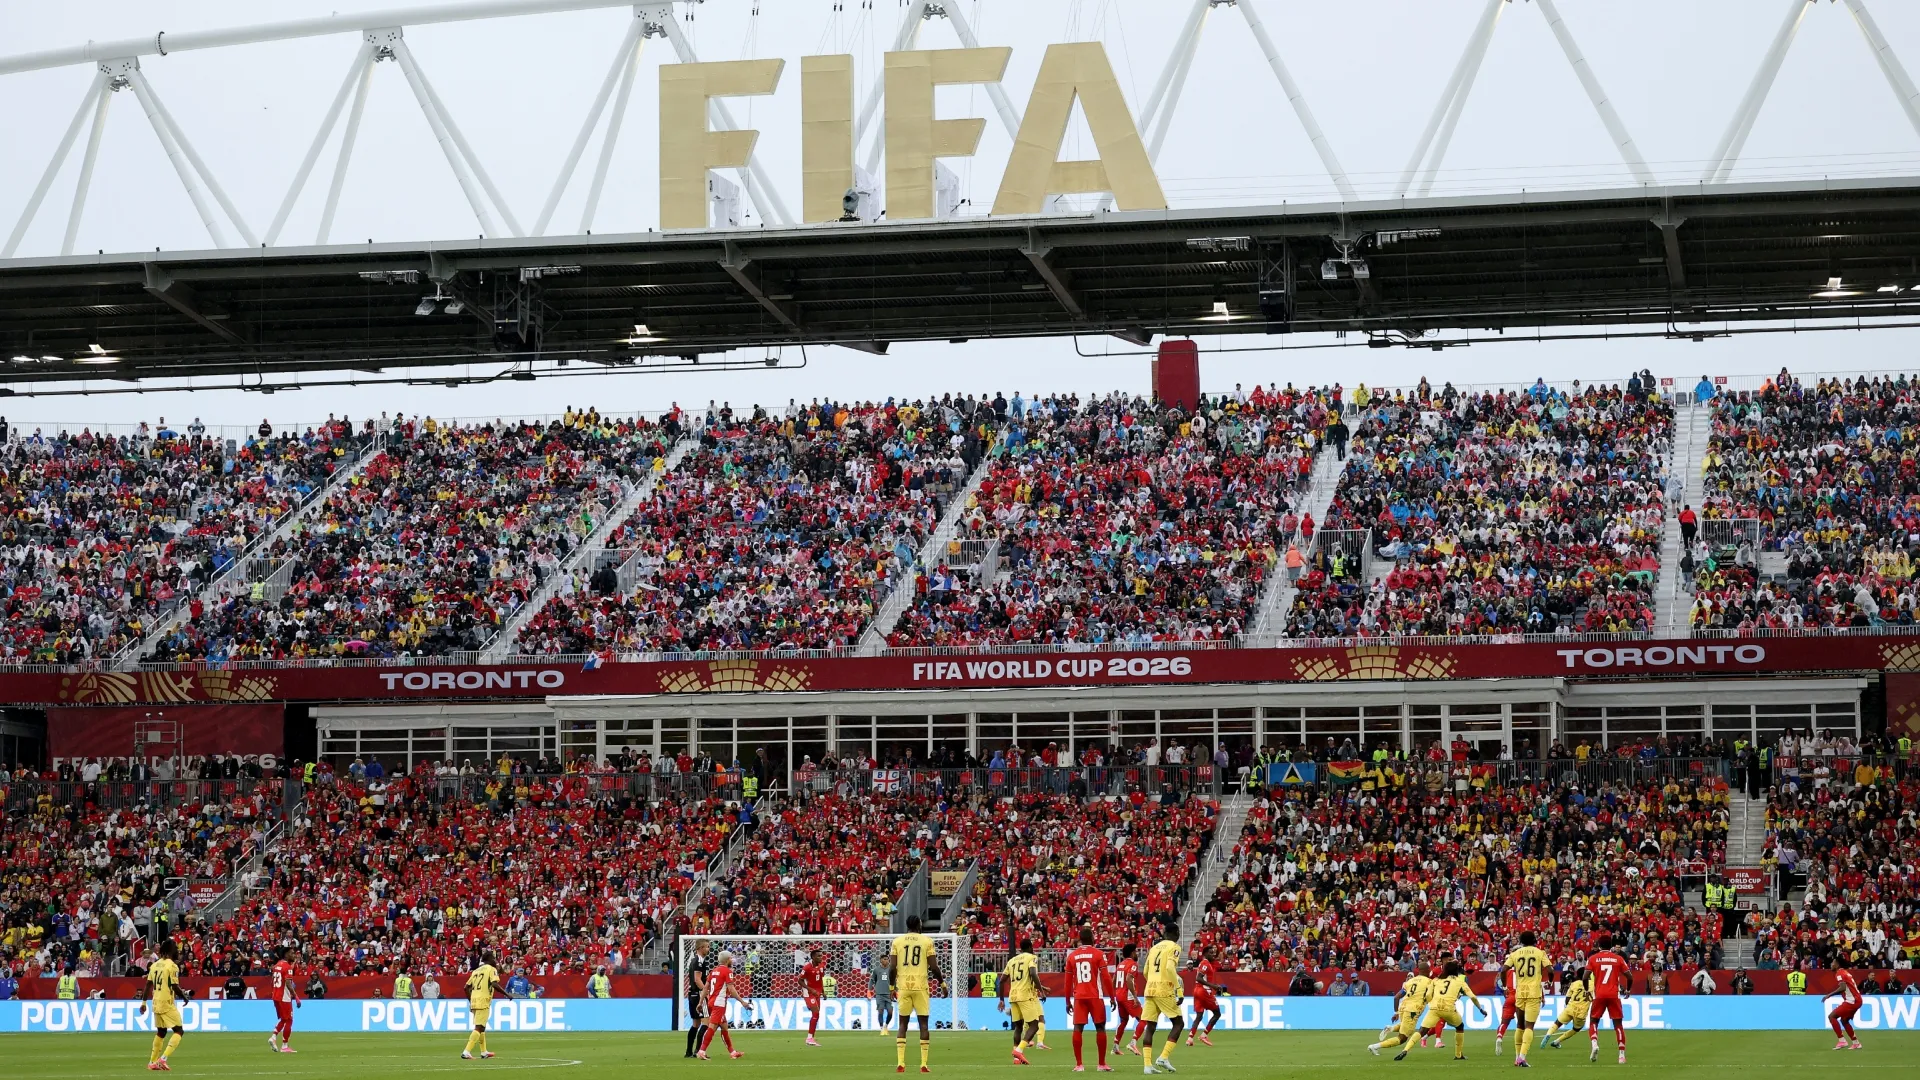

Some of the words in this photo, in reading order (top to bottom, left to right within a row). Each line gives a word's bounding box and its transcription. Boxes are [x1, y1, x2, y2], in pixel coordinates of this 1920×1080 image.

[659, 41, 1167, 230] FIFA
[1556, 645, 1766, 668] TORONTO
[913, 662, 963, 680] FIFA
[966, 660, 1052, 679] WORLD
[1056, 659, 1103, 678] CUP
[1107, 657, 1192, 676] 2026
[379, 670, 565, 690] TORONTO
[1199, 766, 1211, 775] 115
[1776, 758, 1788, 767] 117
[726, 774, 738, 782] 114
[796, 772, 807, 780] 115
[902, 944, 922, 967] 18
[1153, 951, 1162, 973] 4
[1010, 962, 1025, 982] 15
[1075, 961, 1092, 984] 18
[1516, 956, 1537, 978] 26
[1600, 964, 1613, 985] 7
[153, 969, 164, 992] 14
[472, 973, 485, 991] 22
[709, 977, 717, 996] 6
[1115, 970, 1125, 989] 14
[1439, 979, 1451, 996] 3
[208, 986, 258, 1000] FIA
[1407, 983, 1418, 998] 9
[21, 1002, 222, 1031] POWERDE
[362, 1001, 566, 1030] POWEADE
[726, 1000, 919, 1030] OWERAD
